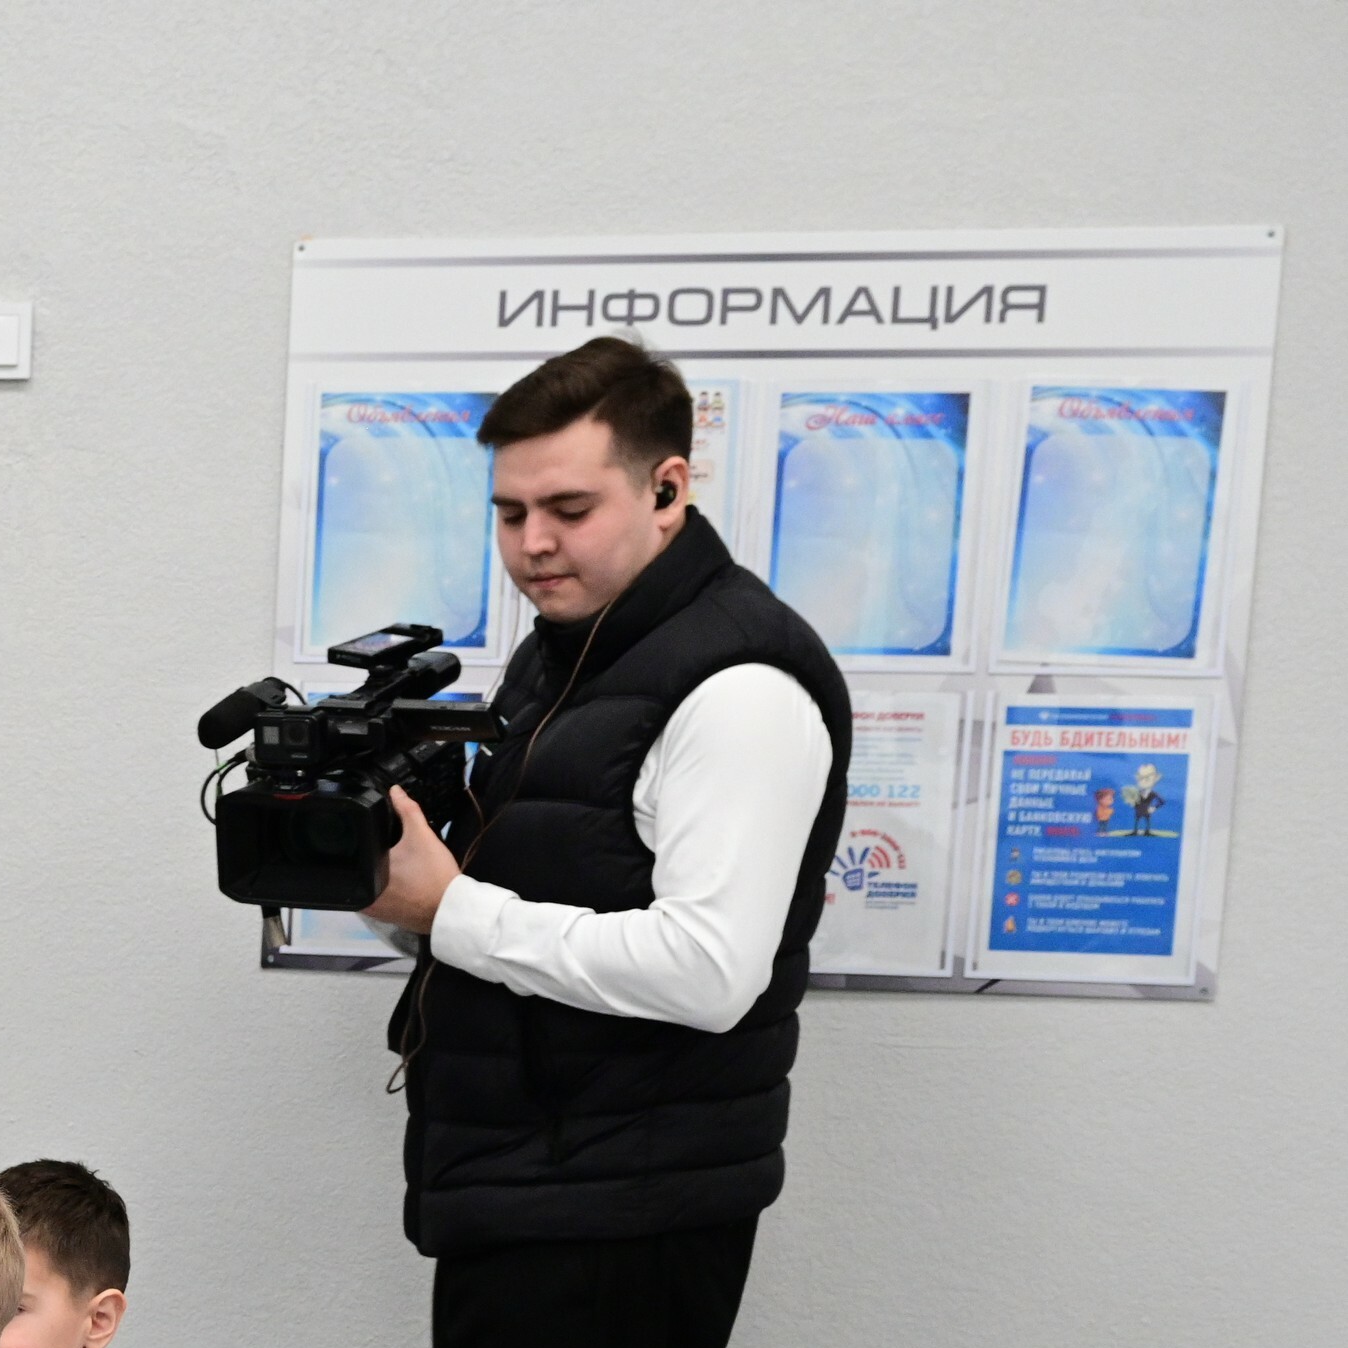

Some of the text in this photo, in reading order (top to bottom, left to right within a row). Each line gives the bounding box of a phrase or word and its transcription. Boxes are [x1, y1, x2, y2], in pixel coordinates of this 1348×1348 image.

[497, 285, 1047, 330] ИНФОРМАЦИЯ
[806, 404, 876, 430] Наш
[1010, 730, 1189, 749] БУДЬ БДИТЕЛЬНЫМ!
[888, 785, 921, 798] 122
